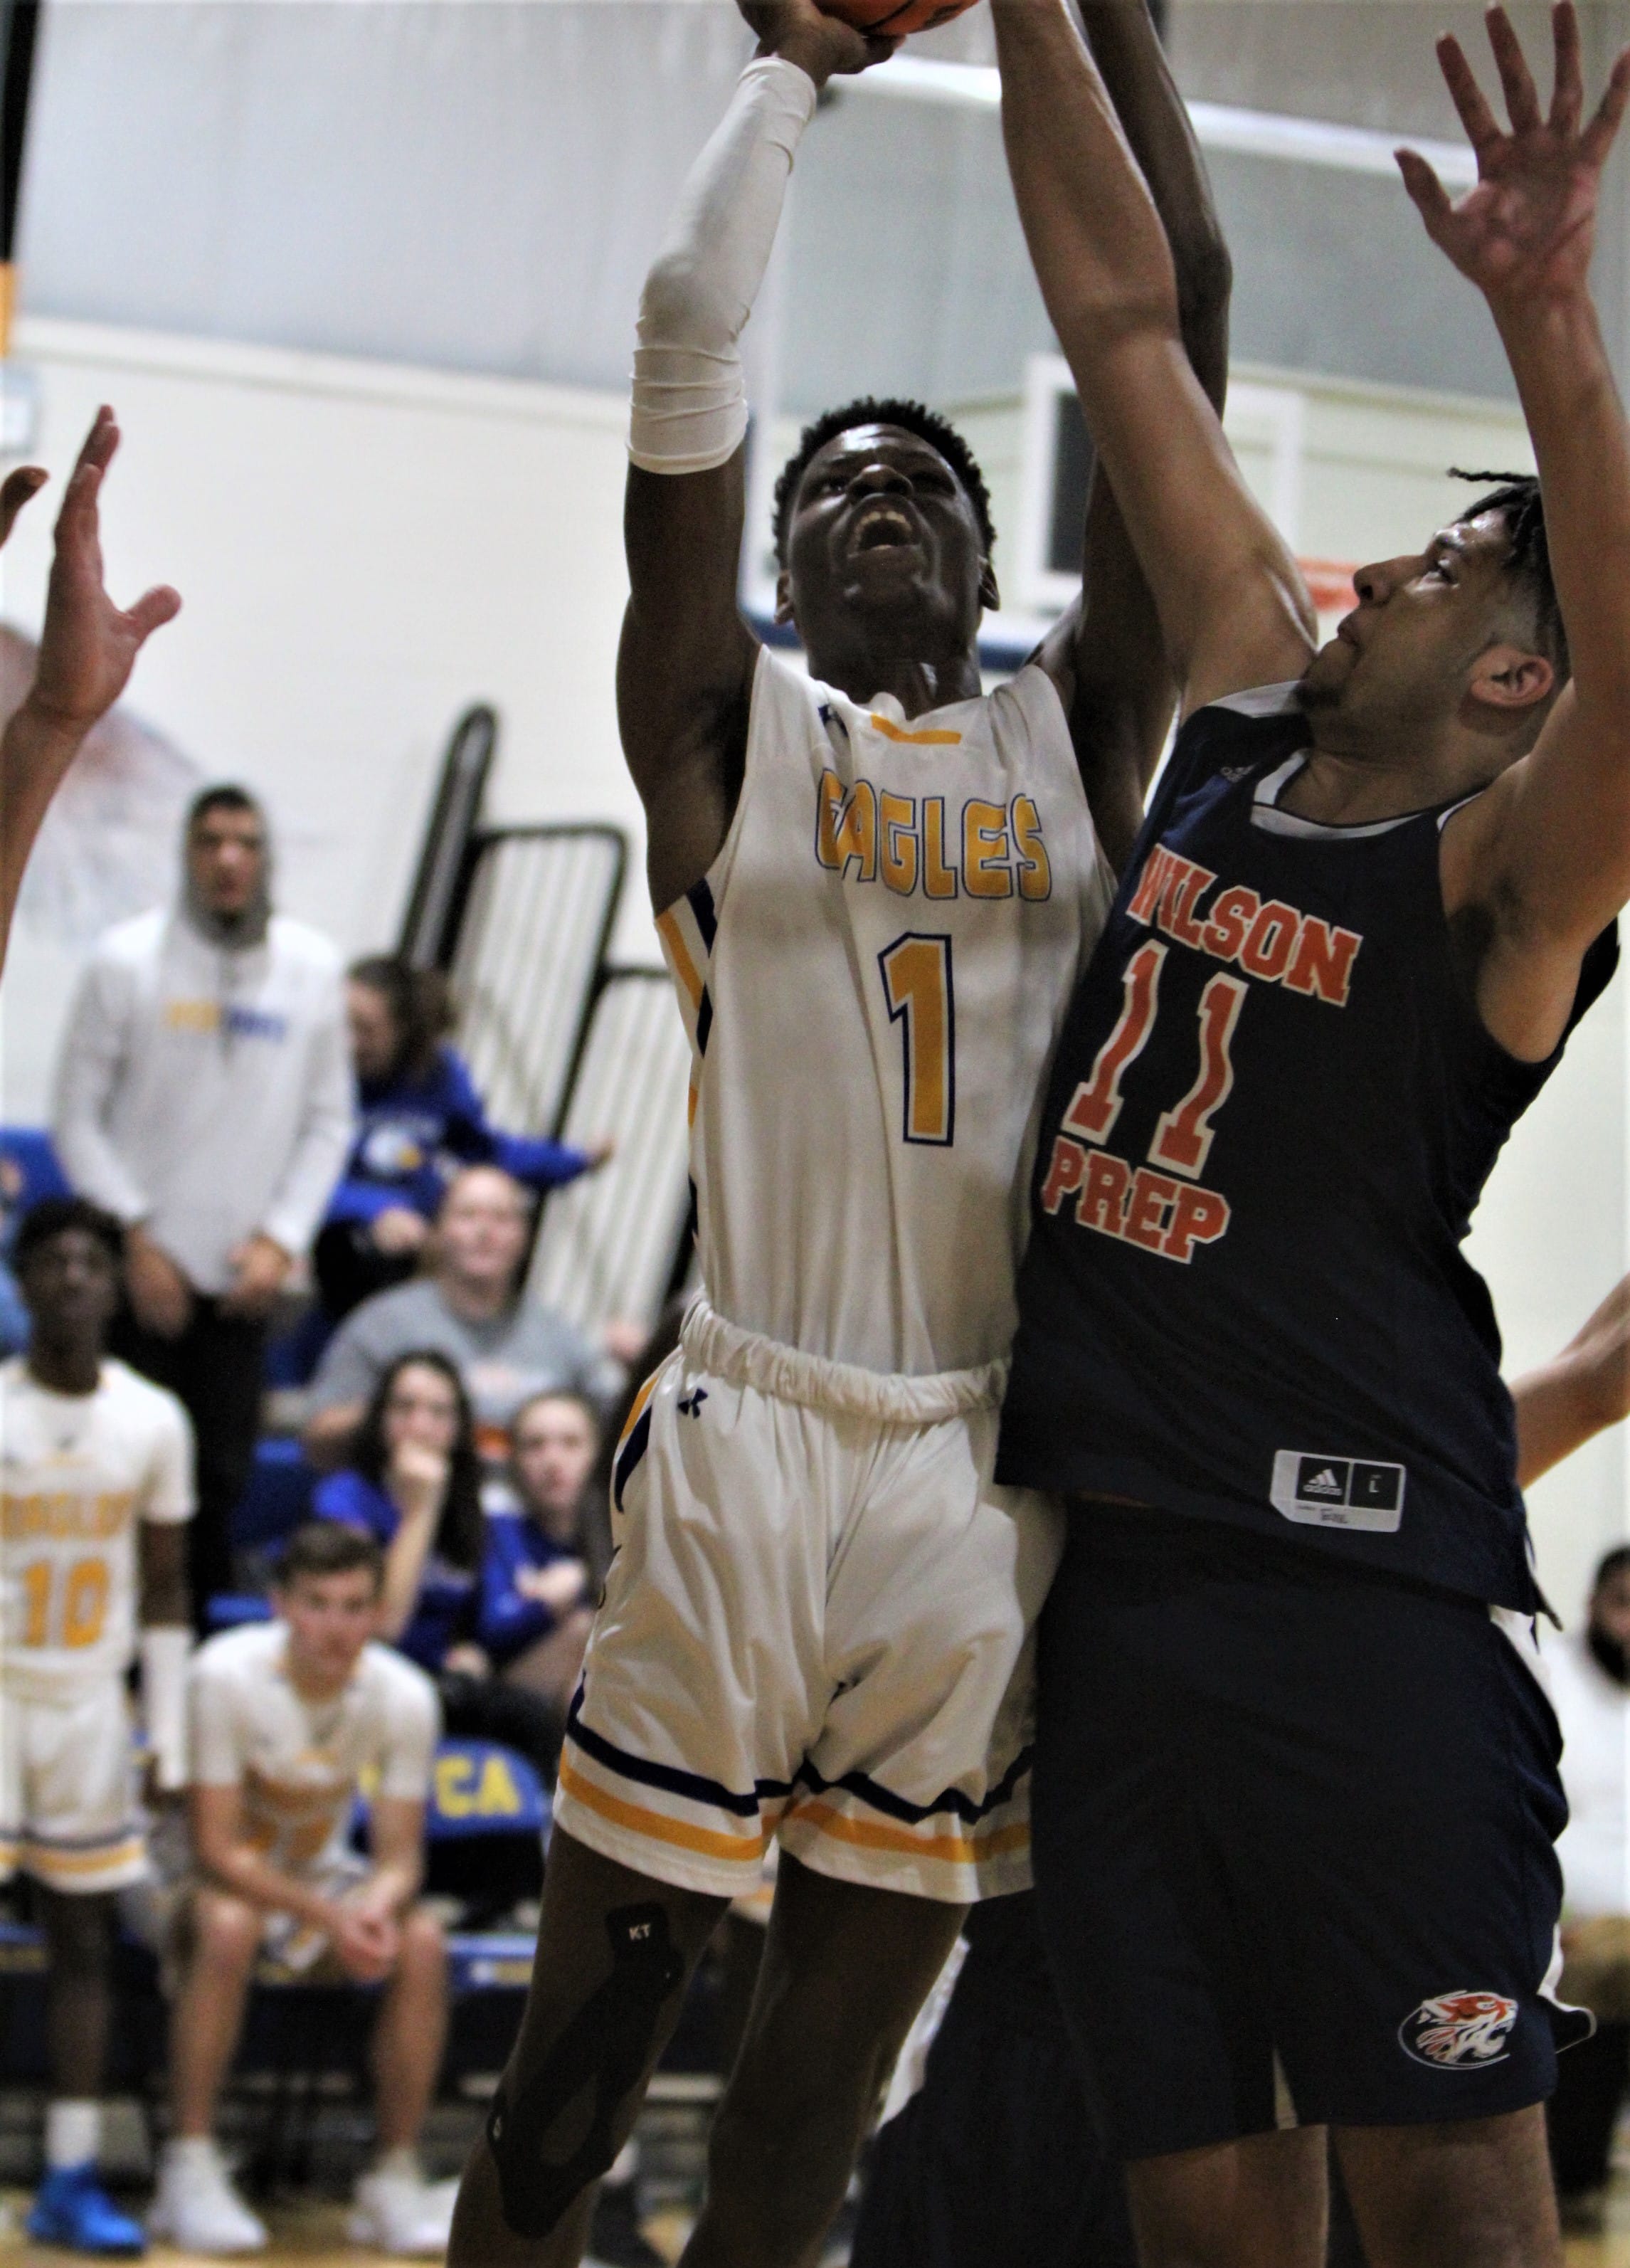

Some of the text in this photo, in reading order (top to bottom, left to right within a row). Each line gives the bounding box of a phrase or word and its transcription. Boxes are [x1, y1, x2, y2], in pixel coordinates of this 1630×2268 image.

[815, 768, 1052, 902] EAGLES
[1126, 843, 1364, 1008] WILSON
[877, 931, 956, 1147] 1
[1060, 938, 1250, 1181] 11
[1041, 1136, 1232, 1265] PREP
[22, 1558, 110, 1650] 10
[629, 1924, 650, 1941] KT
